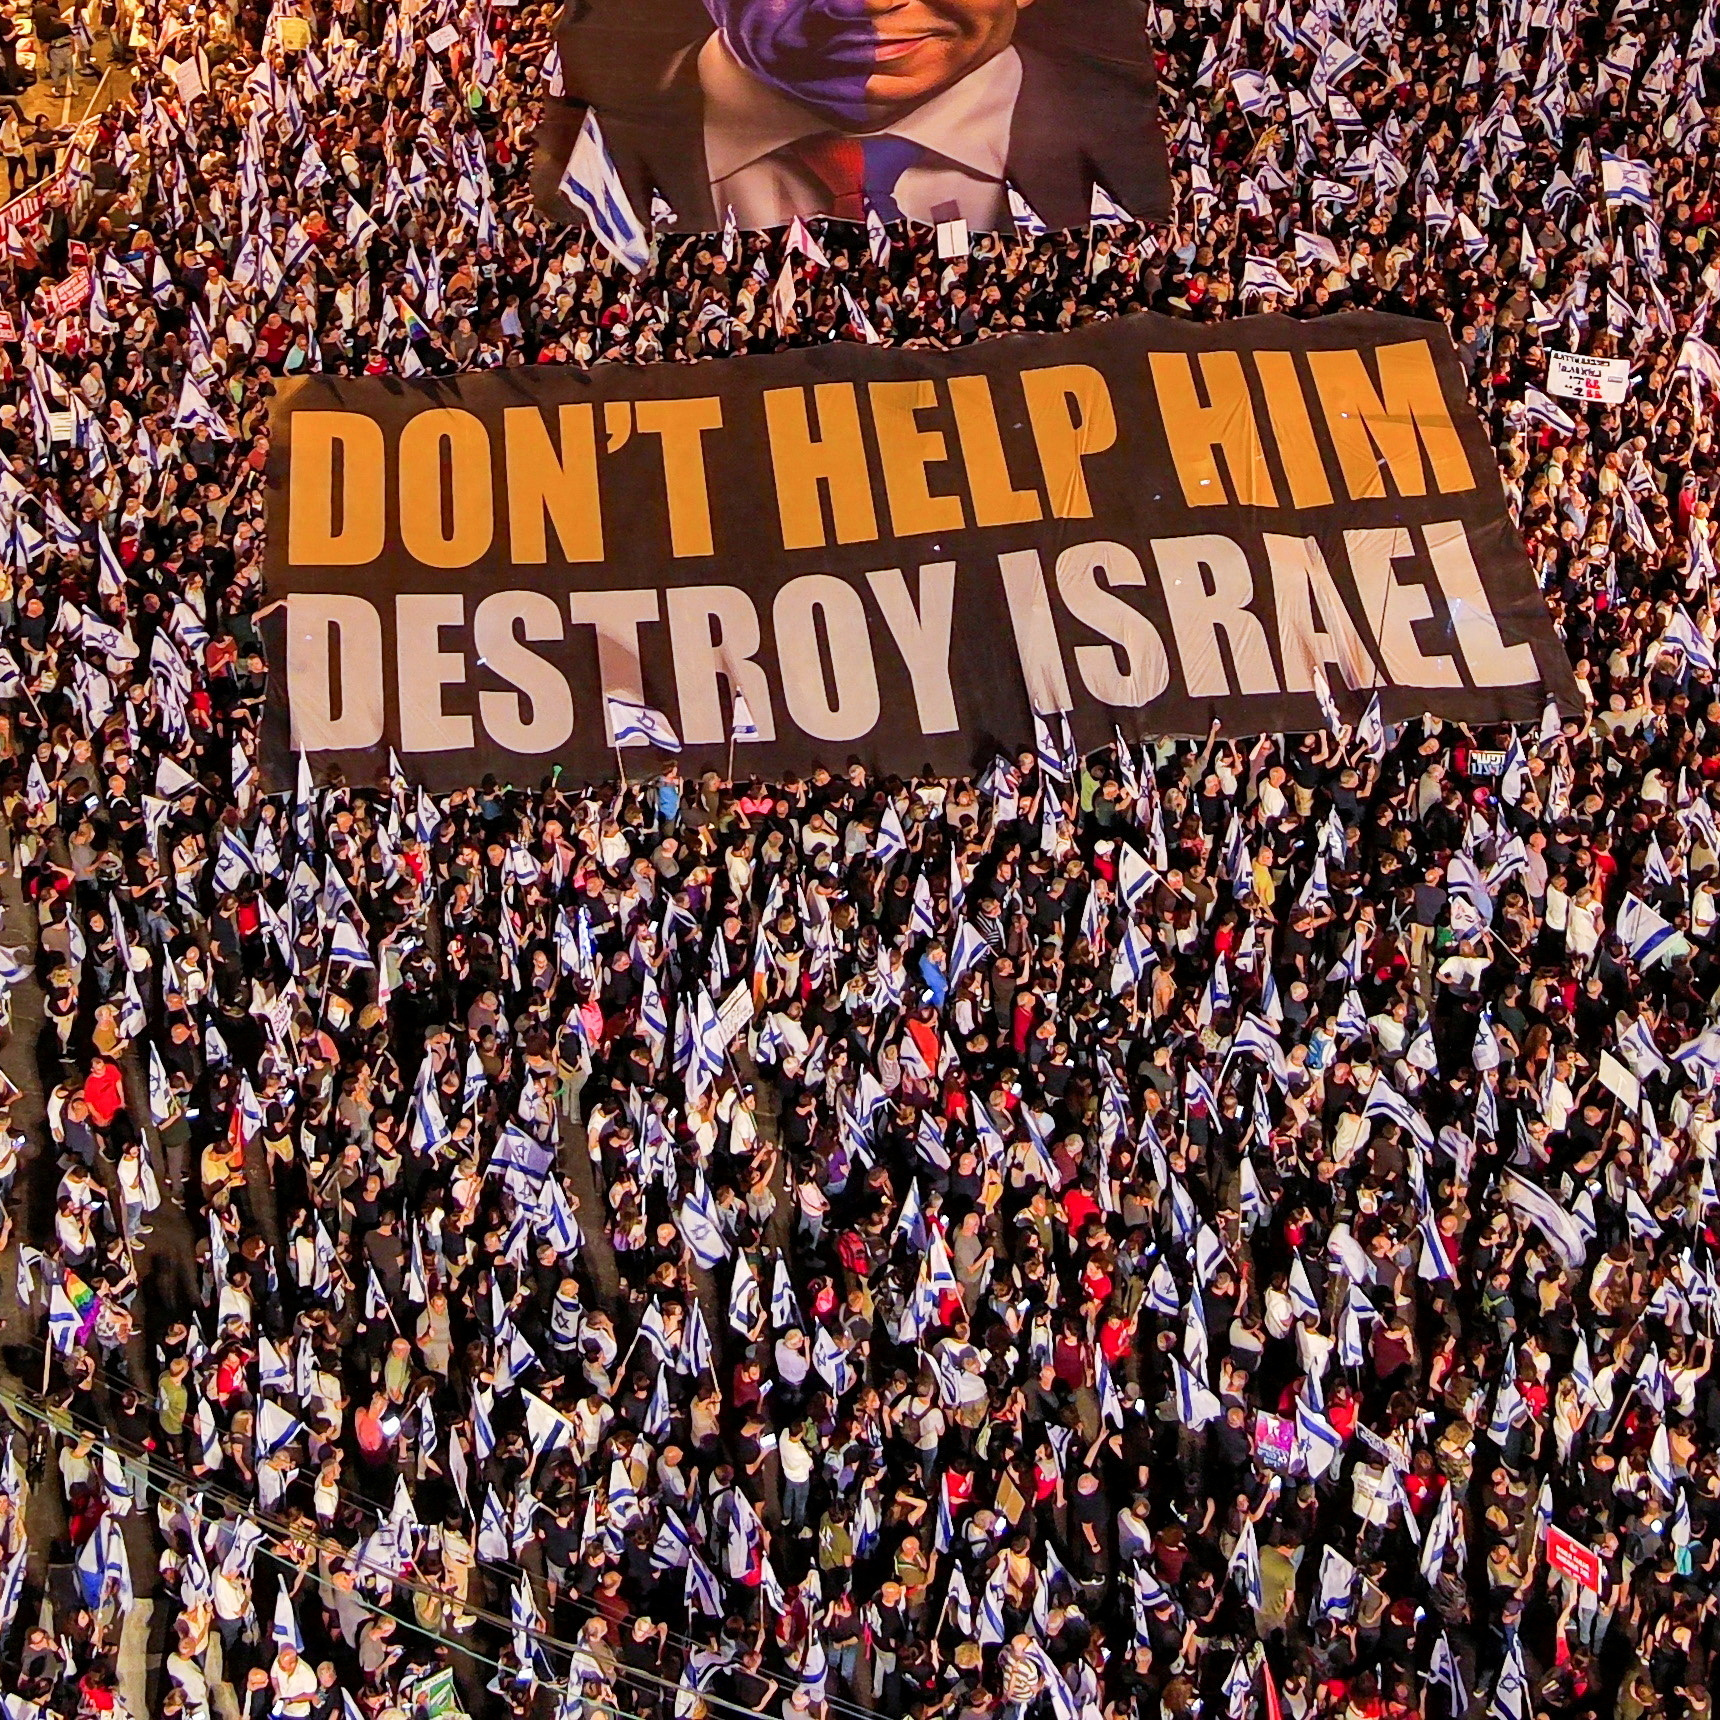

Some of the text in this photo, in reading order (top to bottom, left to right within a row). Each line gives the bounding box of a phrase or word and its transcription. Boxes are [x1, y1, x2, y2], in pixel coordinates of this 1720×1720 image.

[288, 340, 1475, 568] DON'T HELP HIM
[287, 520, 1540, 756] DESTROY ISRAEL
